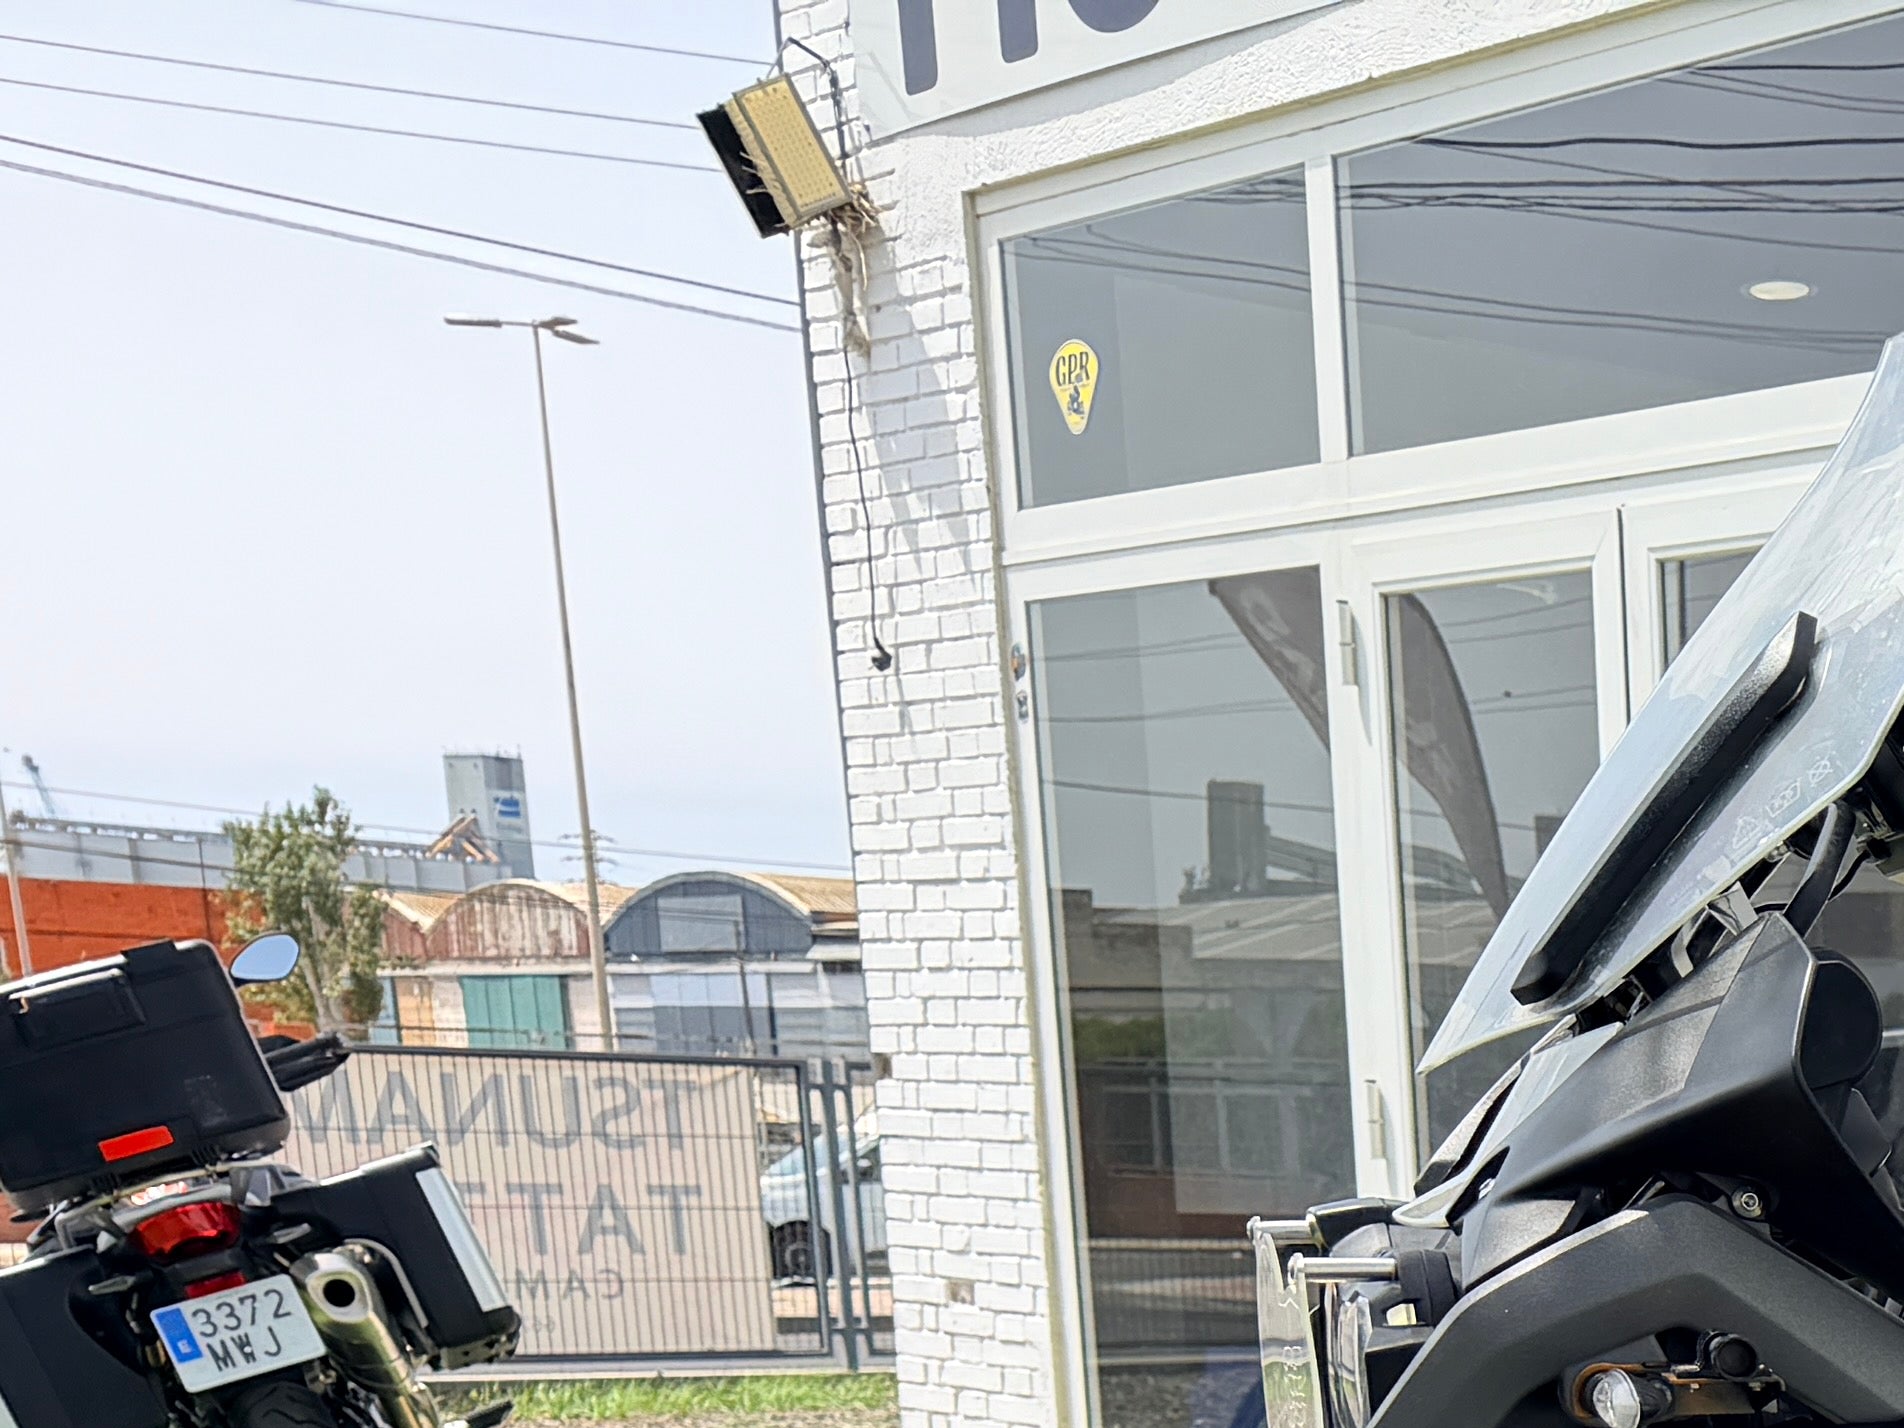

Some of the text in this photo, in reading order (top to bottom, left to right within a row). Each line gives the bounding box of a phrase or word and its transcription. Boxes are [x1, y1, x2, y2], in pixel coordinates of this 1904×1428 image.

[1056, 351, 1090, 387] GPR
[191, 1289, 292, 1338] 3372
[206, 1325, 282, 1372] MWJ
